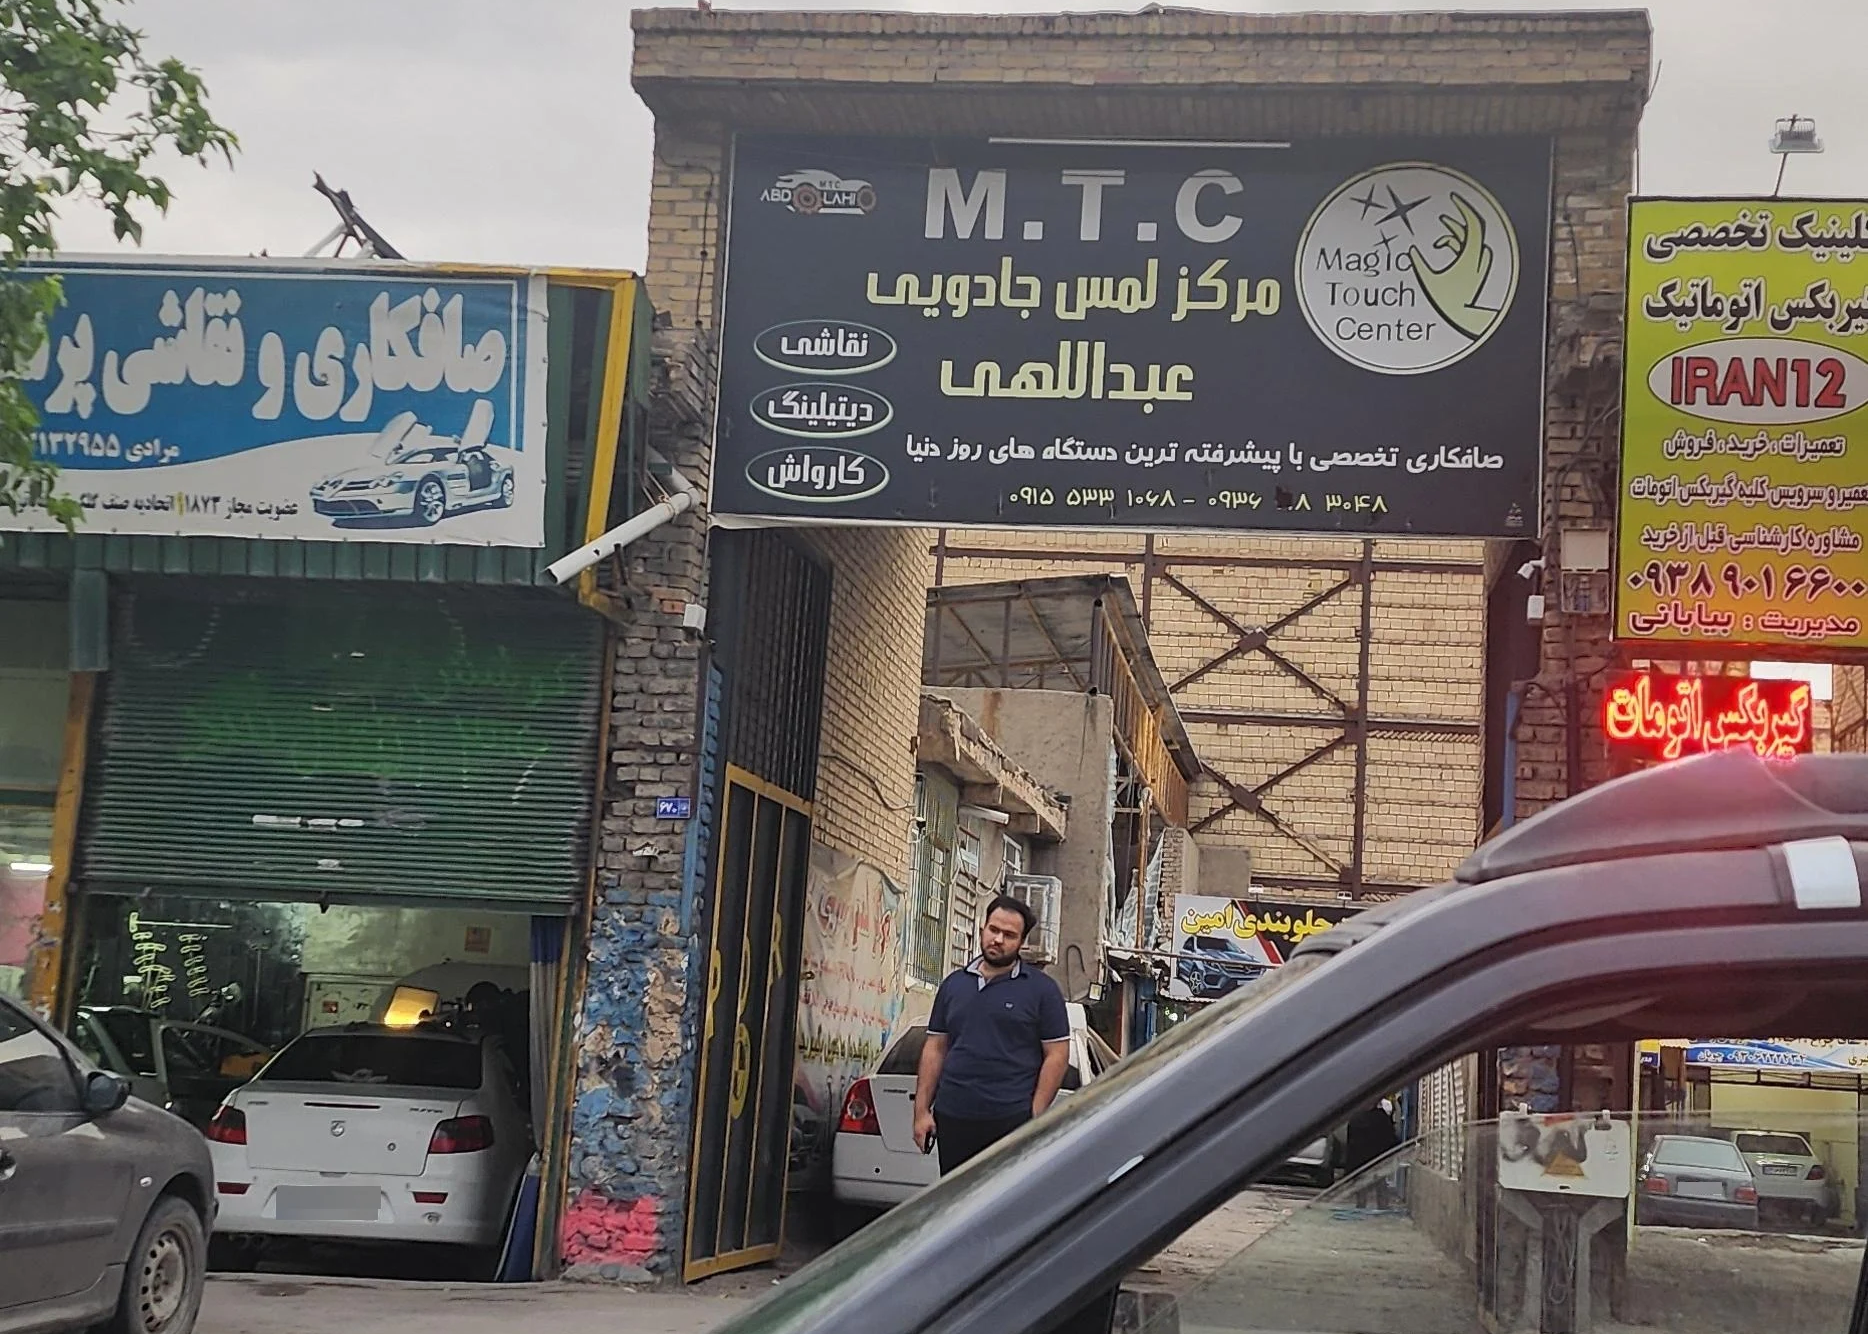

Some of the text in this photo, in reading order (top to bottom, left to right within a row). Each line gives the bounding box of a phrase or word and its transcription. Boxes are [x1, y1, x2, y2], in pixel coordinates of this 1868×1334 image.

[819, 180, 841, 189] MTC
[925, 168, 1243, 243] M.T.C
[1644, 210, 1868, 260] لینیک تخصصی
[1316, 247, 1413, 278] Magic
[866, 255, 1281, 323] مرکز لمس جادویی
[1325, 280, 1415, 307] Touch
[1643, 278, 1868, 334] یربکس اتوماتیک
[780, 327, 869, 357] نقاشی
[1335, 317, 1436, 342] Center
[102, 286, 245, 415] نقاشی
[293, 287, 506, 422] صافکاری
[252, 331, 285, 420] و
[940, 340, 1194, 414] عبداللهی
[1670, 356, 1847, 409] IRAN12
[768, 390, 874, 428] دیتیلینگ
[125, 438, 181, 463] مرادی
[906, 434, 1505, 474] صافکاری تخصصی با پیشرفته ترین دستگاه های روز دنیا
[1664, 428, 1716, 459] فروش
[767, 453, 867, 490] کارواش
[1679, 471, 1738, 506] گیربکس
[1008, 486, 1055, 506] ۰۹۱۵
[1065, 488, 1115, 506] ۵۳۳
[1127, 489, 1176, 507] ۱۰۶۸
[1207, 490, 1263, 510] ۰۹۳۶
[1324, 493, 1389, 514] ۳۰۴۸
[1630, 475, 1678, 505] اتومات
[1738, 476, 1769, 506] کلیه
[1770, 484, 1825, 508] سرویس
[1641, 523, 1862, 555] مشاوره کارشناسی قبل از خرید
[1627, 560, 1868, 601] ۰۹۳۸ ۹۰۱ ۶۶۰۰
[1629, 601, 1735, 634] بیابانی
[1759, 610, 1862, 636] مدیریت
[1606, 674, 1703, 759] اتومات
[1180, 904, 1234, 934] امین
